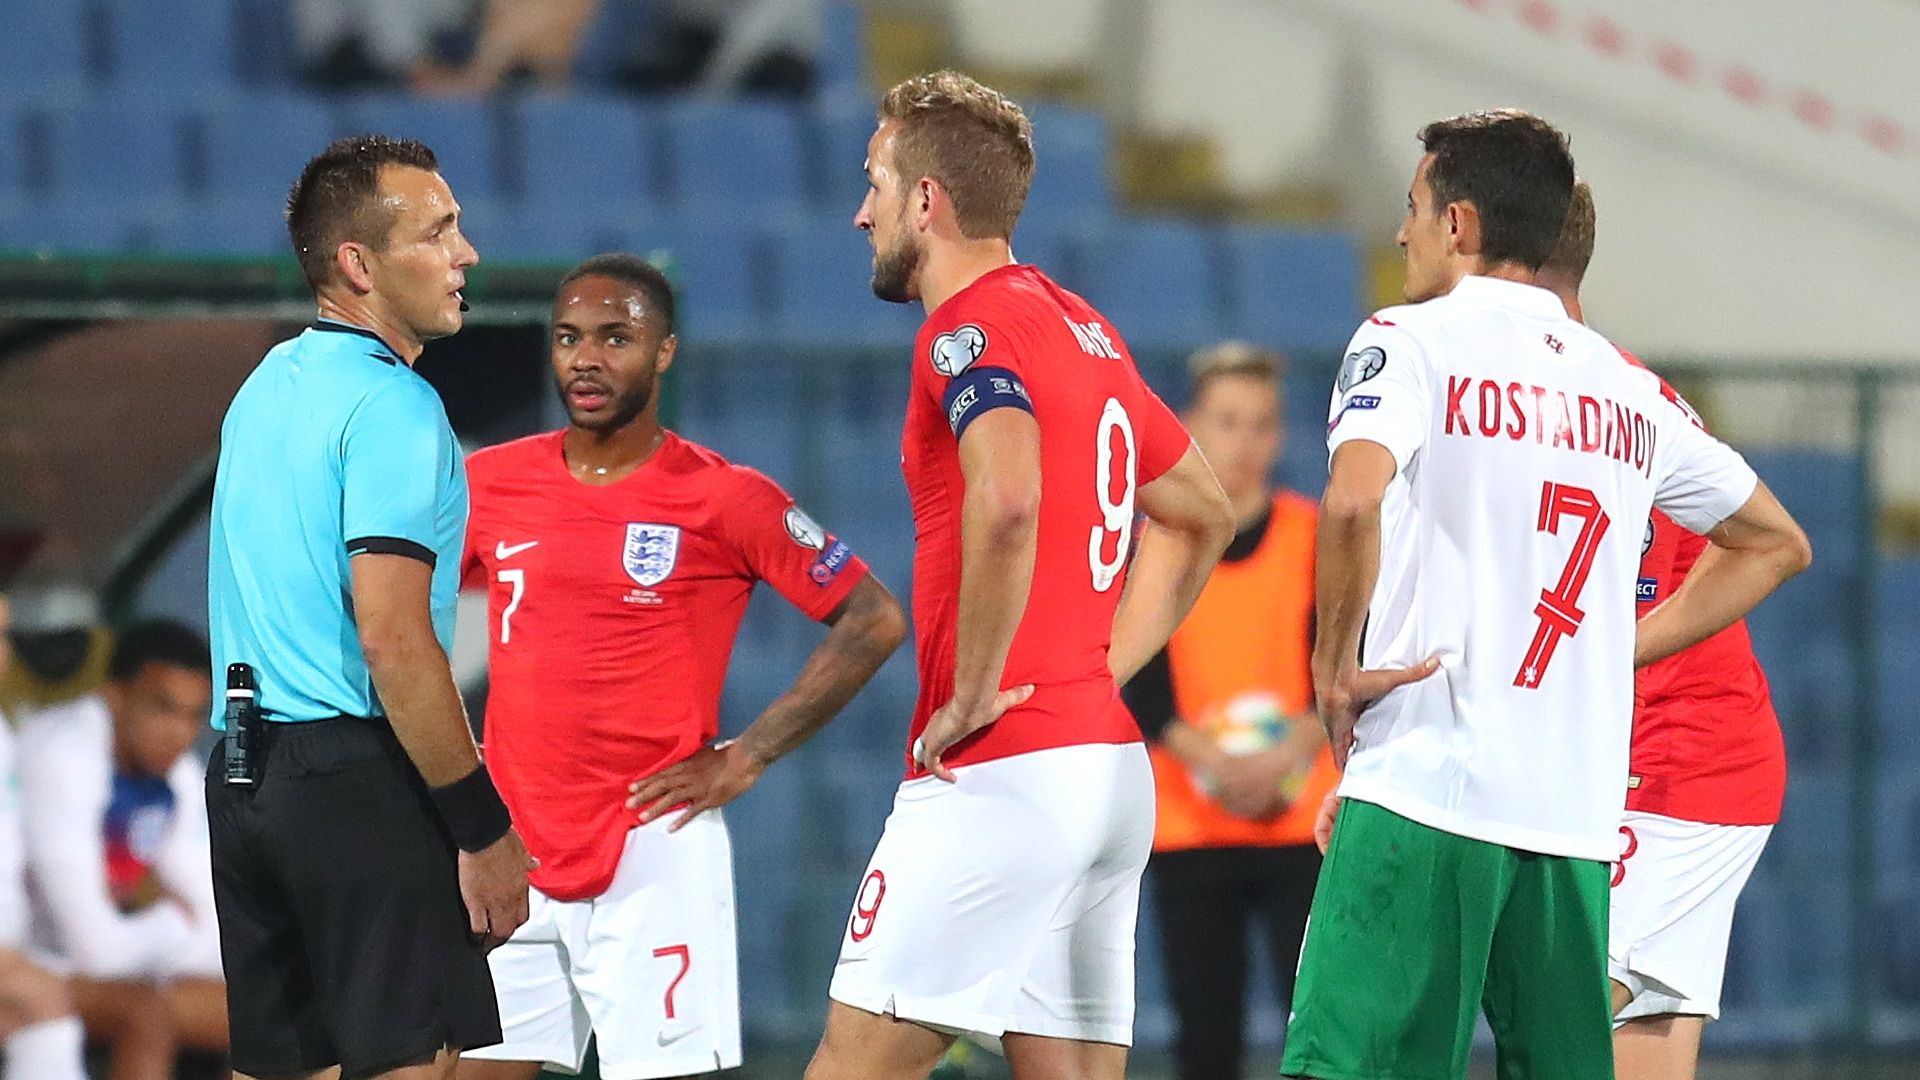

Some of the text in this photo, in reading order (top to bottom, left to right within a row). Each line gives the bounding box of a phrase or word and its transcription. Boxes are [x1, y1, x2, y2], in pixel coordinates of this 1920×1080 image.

[1445, 375, 1656, 479] KOSTADINOV
[1088, 397, 1136, 592] 9
[497, 568, 525, 644] 7
[1512, 481, 1610, 690] 7
[850, 869, 886, 943] 9
[652, 944, 690, 1019] 7
